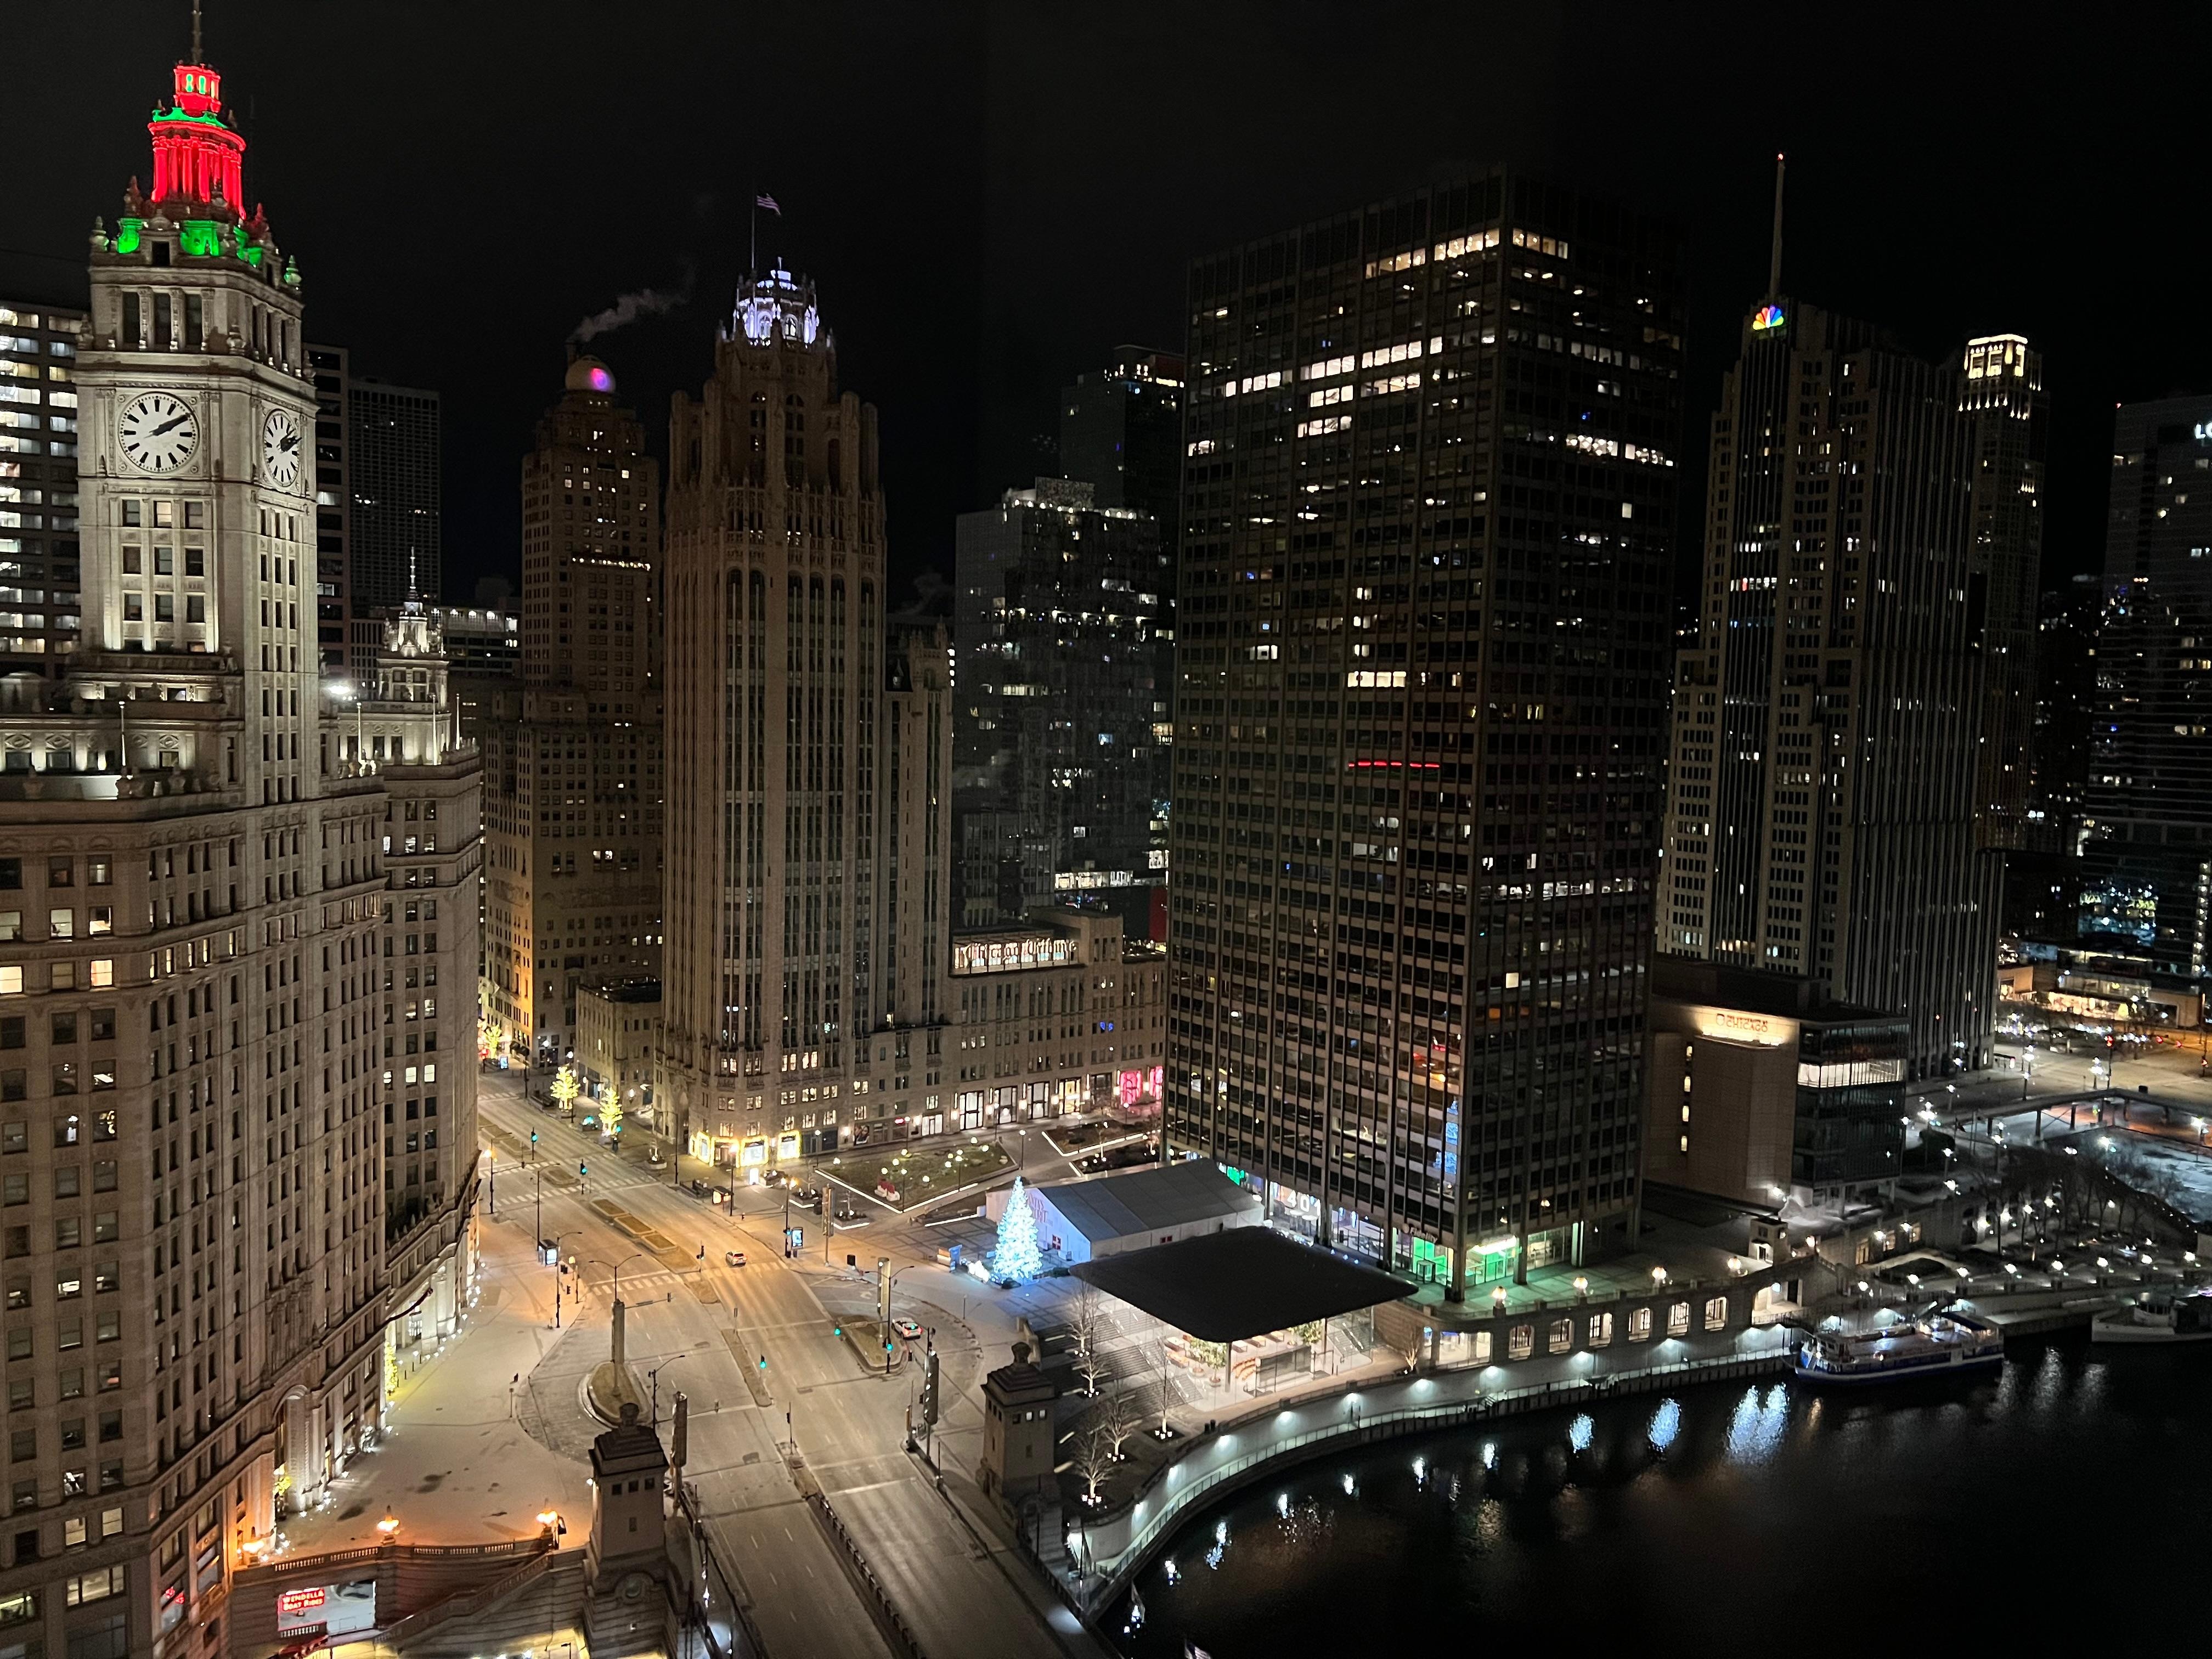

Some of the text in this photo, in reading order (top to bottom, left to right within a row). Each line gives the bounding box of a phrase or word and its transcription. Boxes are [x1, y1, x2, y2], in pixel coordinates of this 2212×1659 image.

[1726, 1019, 1768, 1032] CHICAGO
[1287, 1189, 1321, 1216] 401
[283, 1589, 324, 1603] WENDELLA
[283, 1598, 323, 1611] BOAT RIDES
